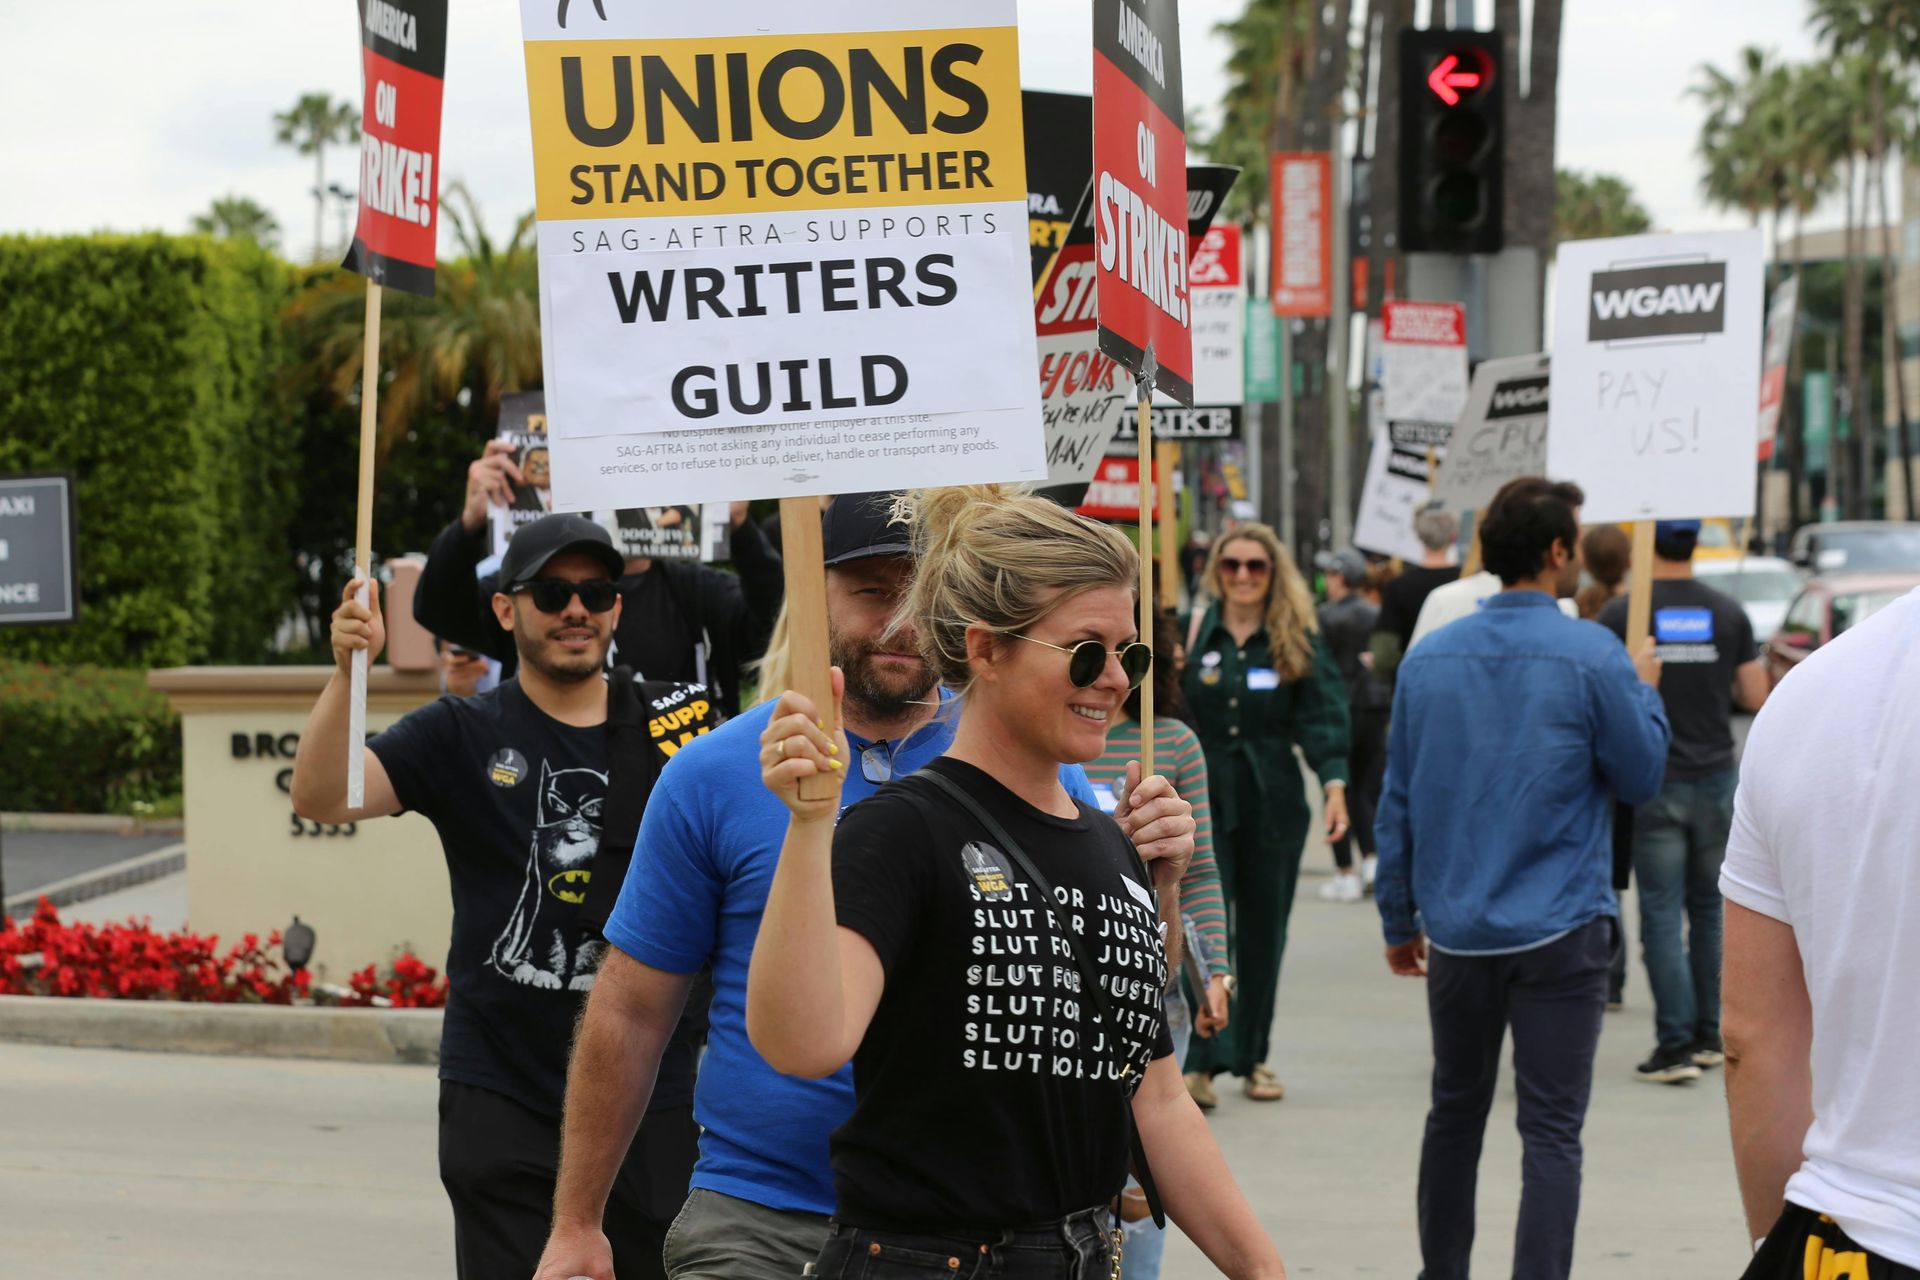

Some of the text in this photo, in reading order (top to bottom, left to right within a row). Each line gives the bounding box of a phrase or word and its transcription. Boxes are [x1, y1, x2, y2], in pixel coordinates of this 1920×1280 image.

[365, 0, 418, 52] AMERICA
[1117, 1, 1166, 91] AMERICA
[375, 79, 397, 129] ON
[560, 43, 989, 148] UNIONS
[569, 150, 994, 205] STAND TOGETHER
[1136, 120, 1156, 189] ON
[361, 131, 432, 228] TRIKE!
[572, 213, 998, 253] SAG-AFTRA SUPPORTS
[1099, 170, 1189, 330] STRIKE!
[607, 253, 958, 324] WRITERS
[1593, 282, 1723, 321] WGAW
[670, 353, 909, 420] GUILD
[1597, 368, 1668, 411] PAY
[616, 425, 980, 458] SAG-AFTRA is not asking any individual to cease performing any
[756, 424, 776, 435] any
[1117, 408, 1233, 439] TRIKE
[1630, 406, 1701, 457] US!
[599, 440, 1000, 476] services, or to refuse to pick up, deliver, handle or transport any goods.
[970, 883, 1029, 903] ST
[1097, 893, 1161, 934] JUSTI
[977, 880, 1009, 892] WGA
[972, 935, 1040, 955] SLUT
[1050, 935, 1076, 961] FO
[974, 908, 1167, 962] SLUT FR JUSTIC
[966, 964, 1044, 986] SLUT
[1053, 965, 1081, 994] FOR
[966, 994, 1046, 1016] SLUT
[965, 1022, 1044, 1046] SLUT
[1052, 1026, 1081, 1050] FO
[963, 1049, 1042, 1074] SLUT
